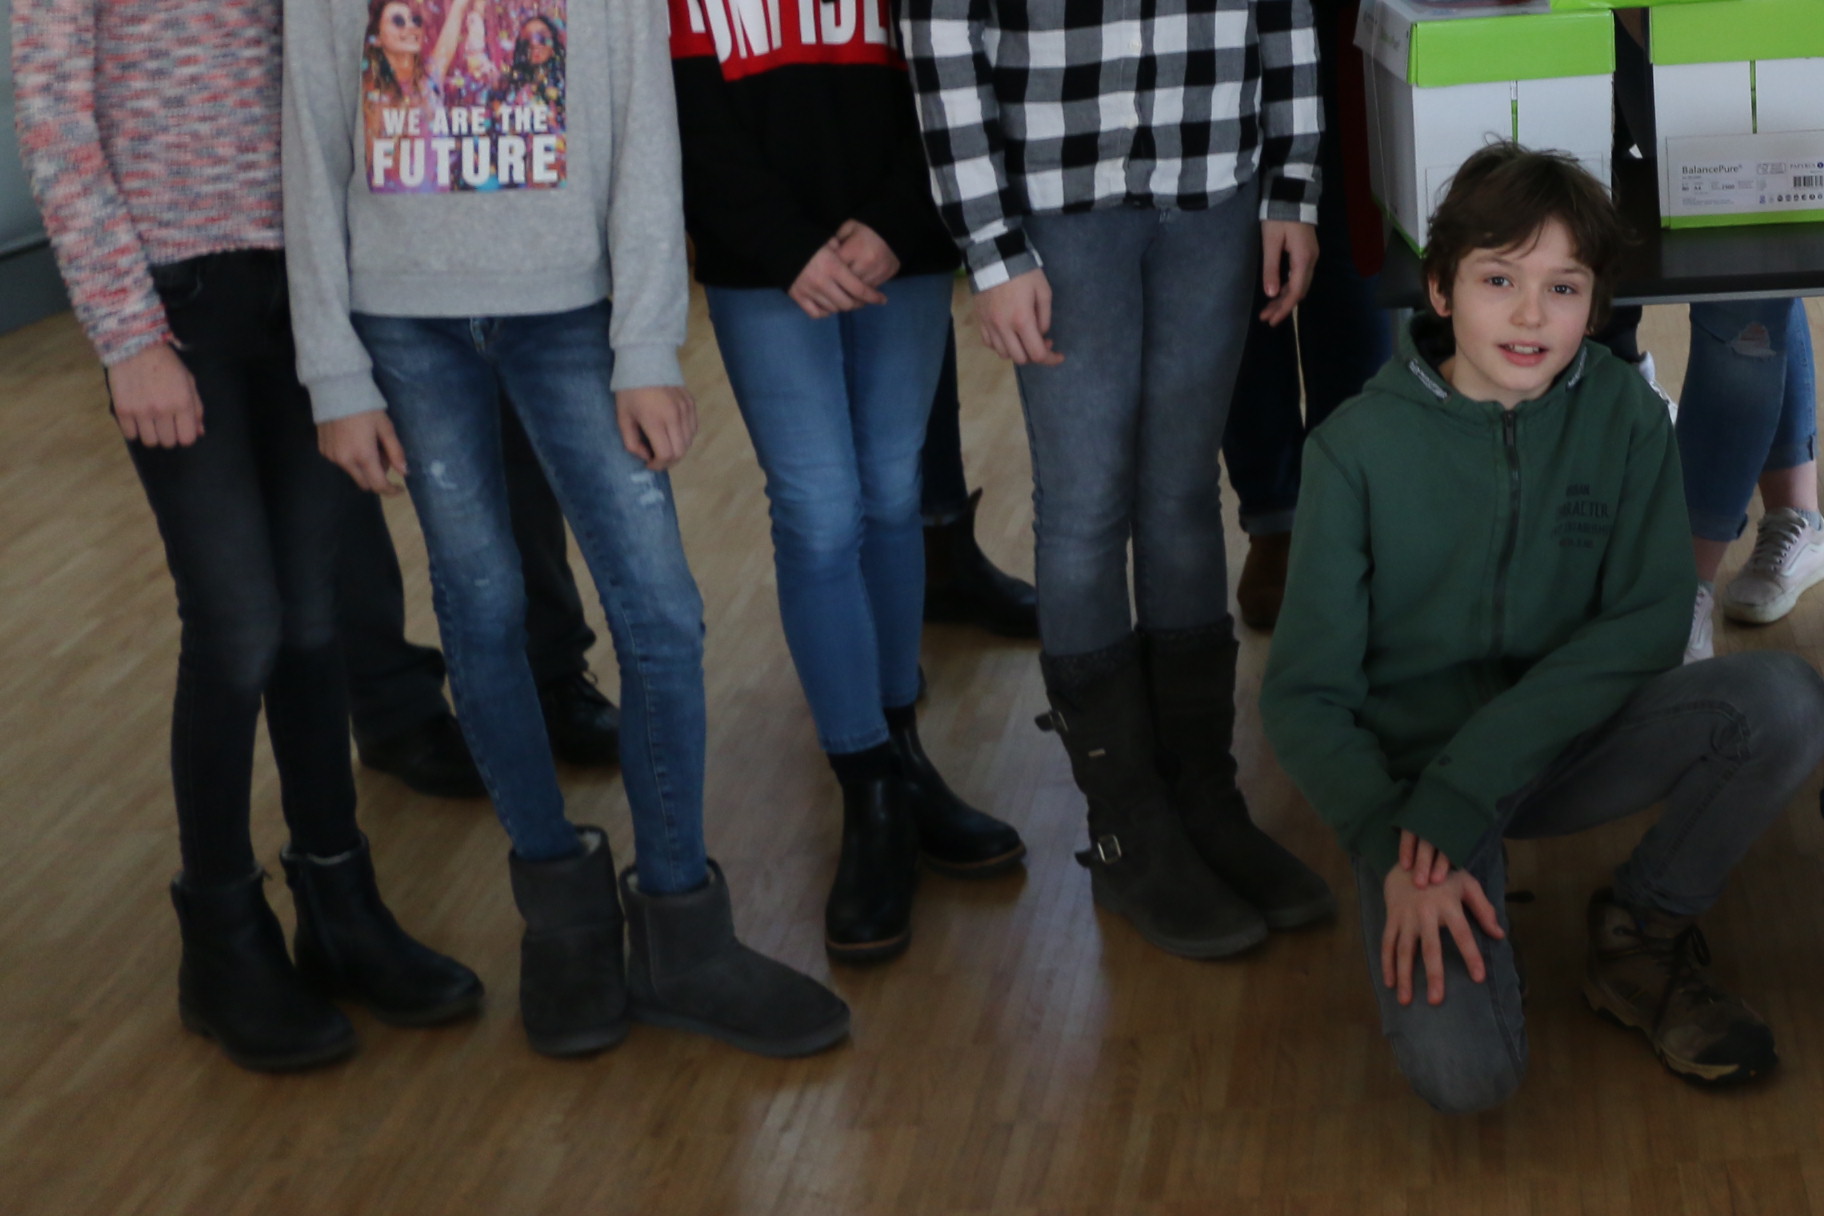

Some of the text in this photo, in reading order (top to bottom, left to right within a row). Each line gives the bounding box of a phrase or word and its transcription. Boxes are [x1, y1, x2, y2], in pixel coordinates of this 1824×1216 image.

[382, 103, 548, 135] WE ARE THE
[371, 134, 559, 187] FUTURE
